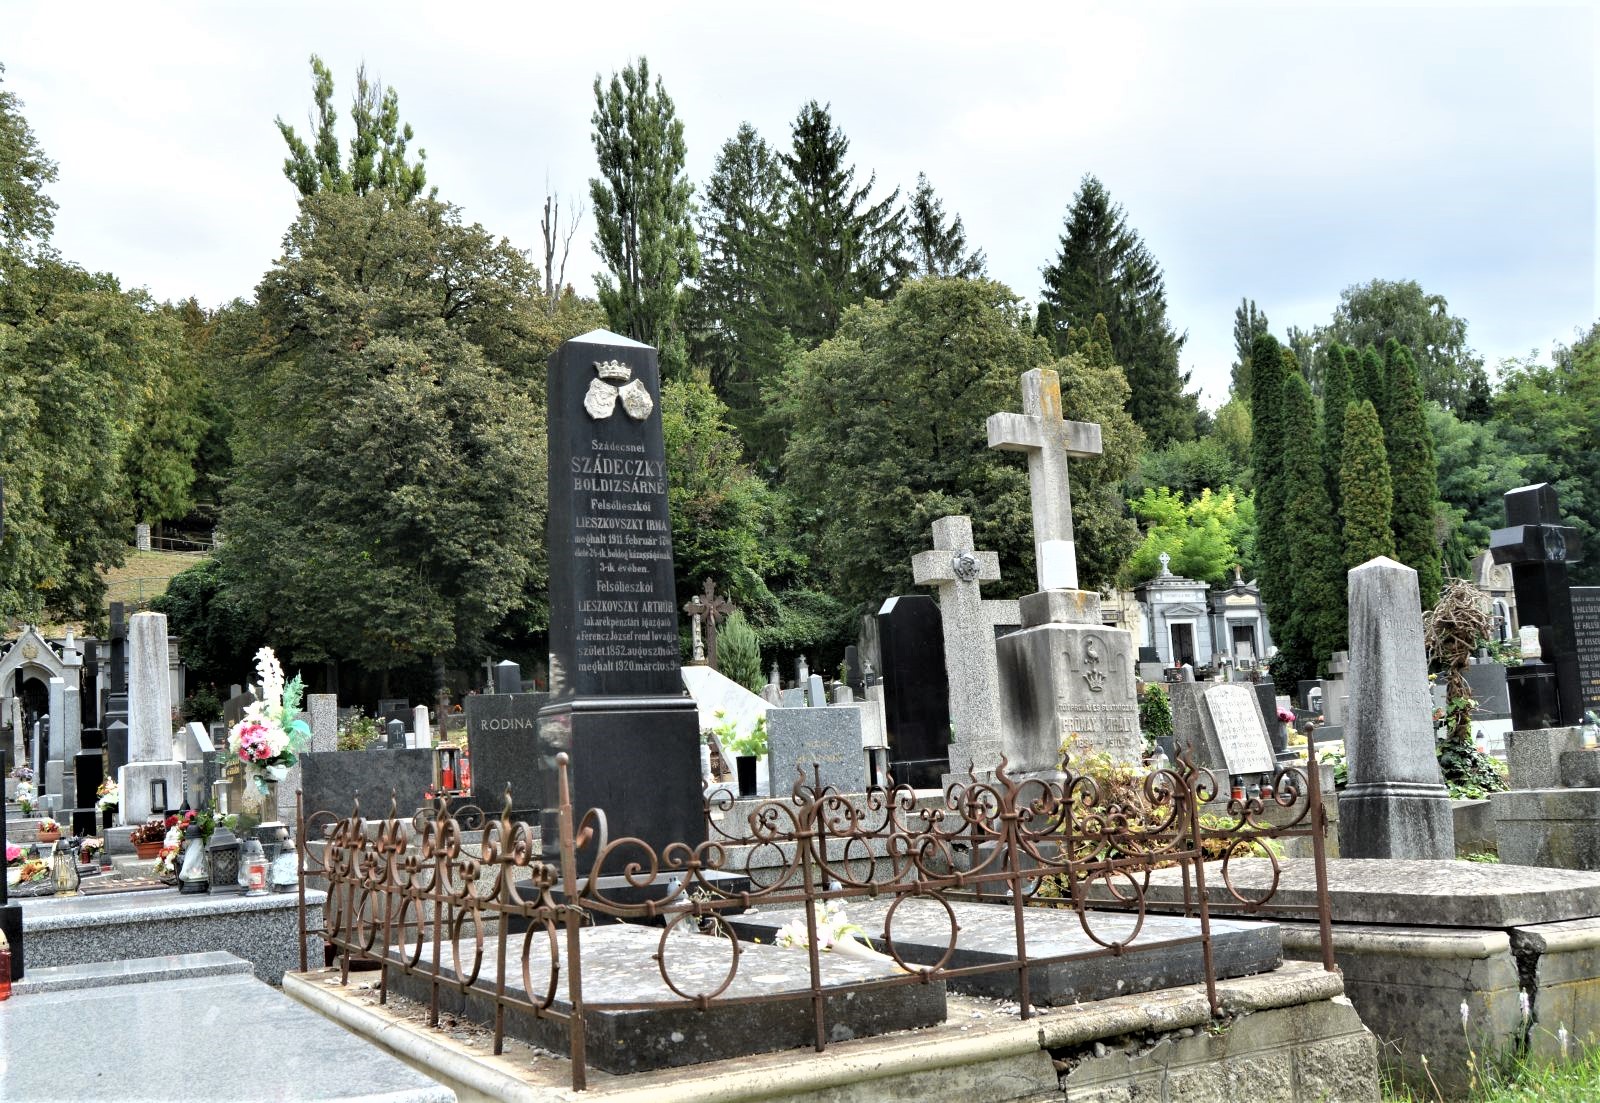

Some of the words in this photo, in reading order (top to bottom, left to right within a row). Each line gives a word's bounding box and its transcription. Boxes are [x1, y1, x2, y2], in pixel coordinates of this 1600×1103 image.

[571, 454, 665, 477] SZÁDECZKY
[574, 477, 665, 494] BOLDIZSÁRNÉ
[575, 517, 644, 530] LIESZKOVSZKY
[646, 519, 667, 531] IRMA
[575, 534, 606, 547] meghalt
[625, 534, 658, 546] február
[578, 600, 639, 613] LIESZKOVSZKY
[578, 660, 614, 674] meghalt
[480, 718, 533, 731] RODINA
